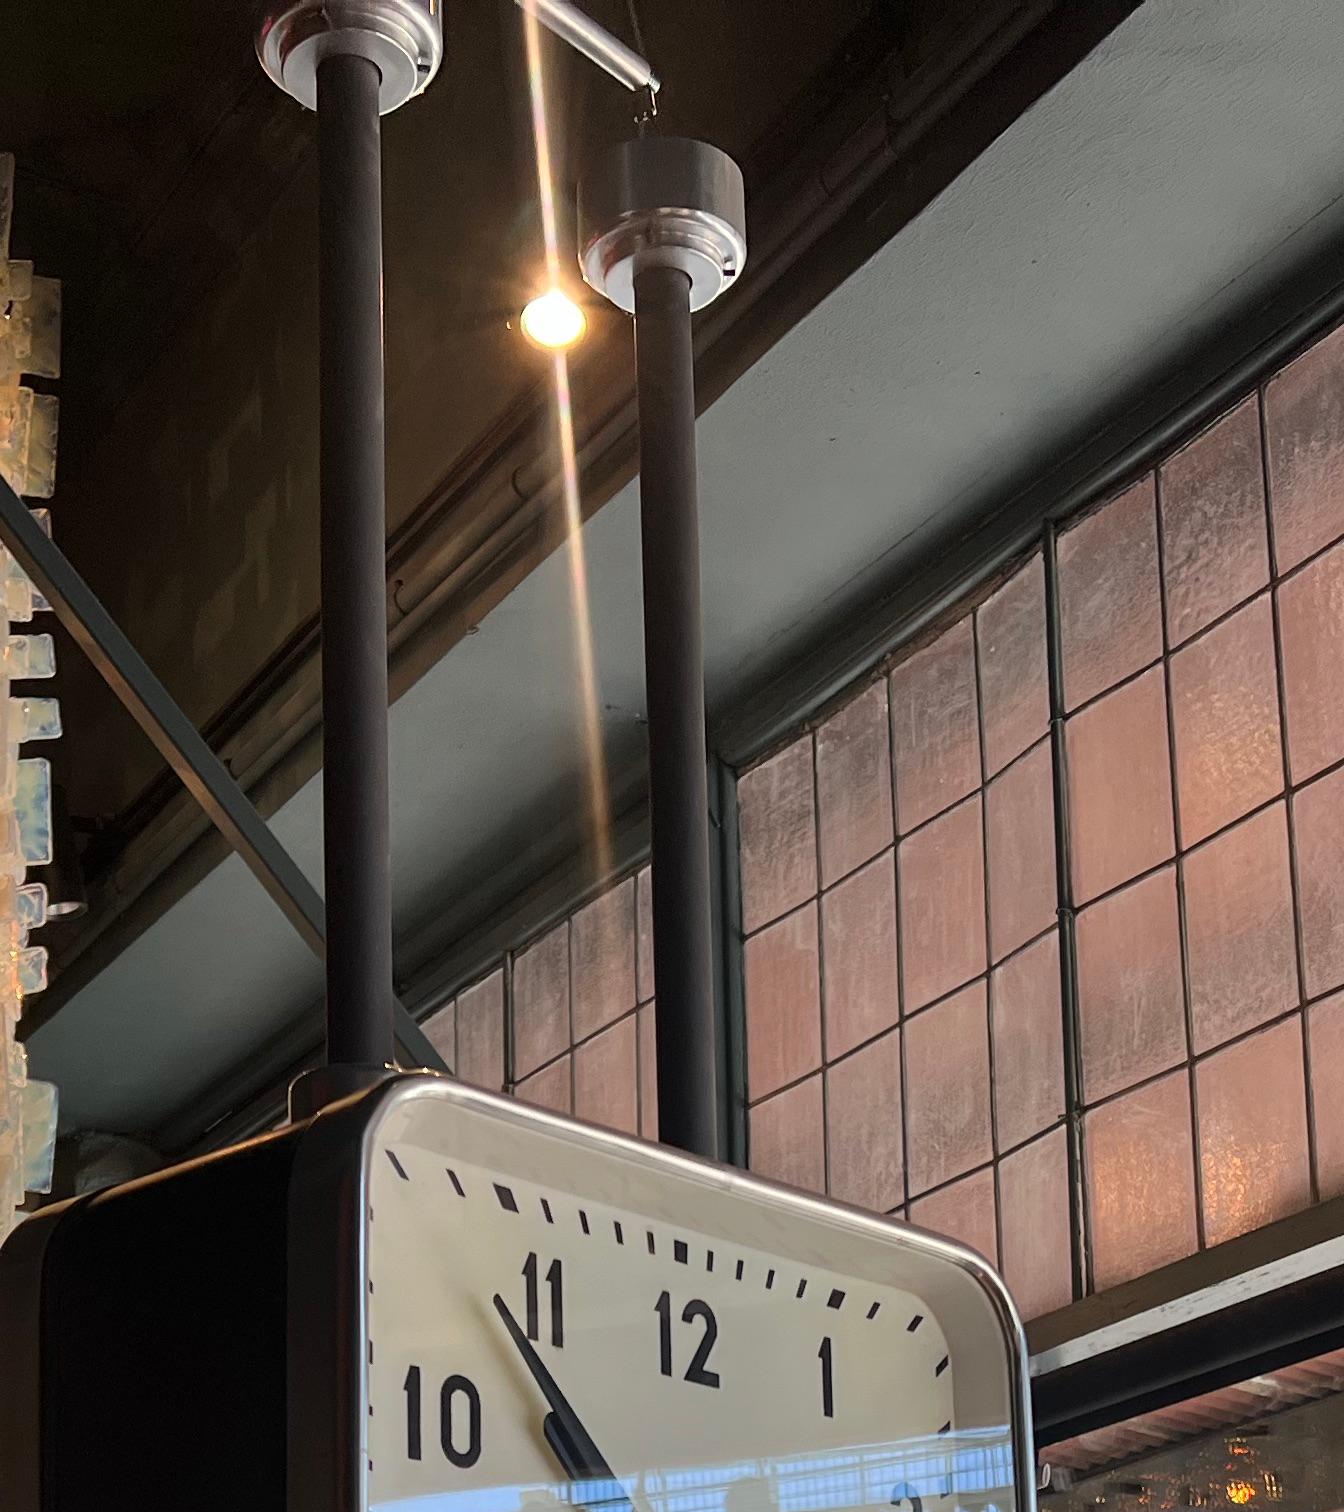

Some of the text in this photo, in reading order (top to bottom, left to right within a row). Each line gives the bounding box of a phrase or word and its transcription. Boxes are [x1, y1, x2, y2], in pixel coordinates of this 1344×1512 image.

[521, 1251, 564, 1349] 11
[654, 1290, 721, 1389] 12
[403, 1364, 482, 1469] 10
[817, 1336, 834, 1418] 1
